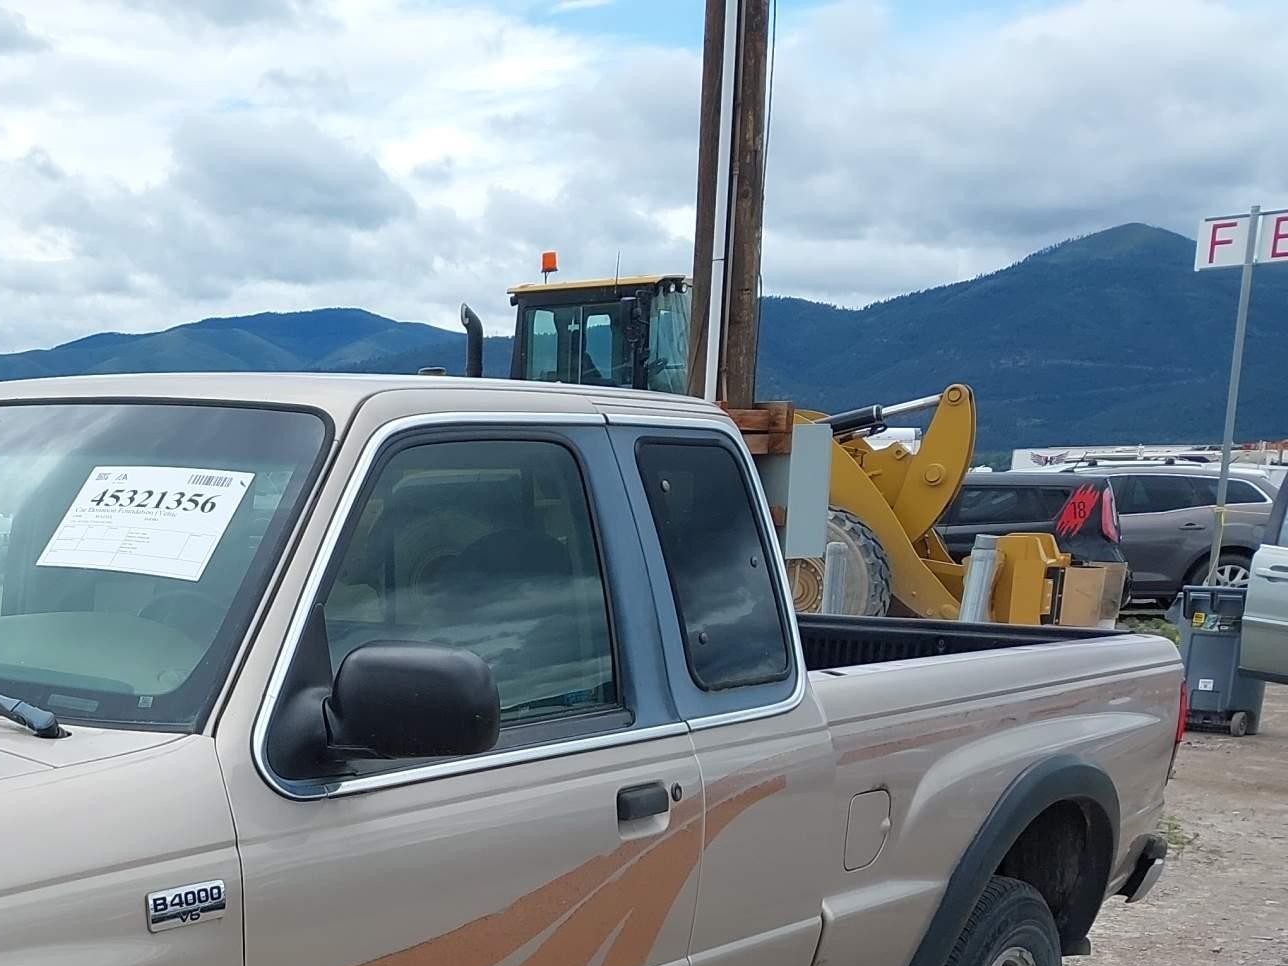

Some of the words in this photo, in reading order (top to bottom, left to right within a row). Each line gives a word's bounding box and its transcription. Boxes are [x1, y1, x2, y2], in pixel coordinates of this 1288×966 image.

[90, 489, 223, 514] 45321356
[1071, 501, 1086, 519] 18
[152, 886, 222, 912] B4000
[179, 908, 201, 922] V6
